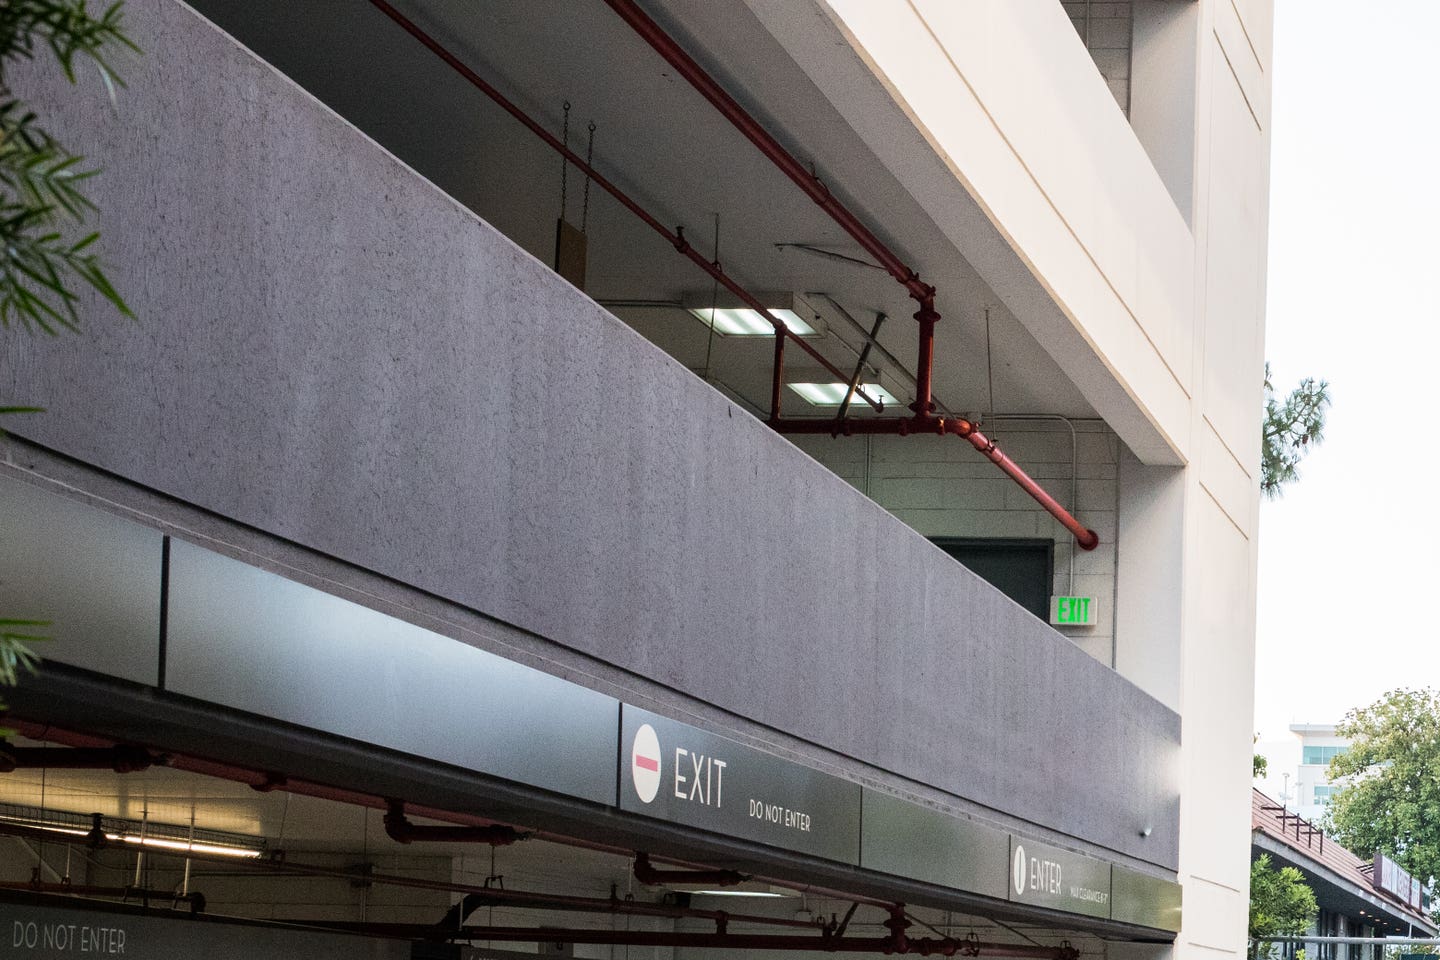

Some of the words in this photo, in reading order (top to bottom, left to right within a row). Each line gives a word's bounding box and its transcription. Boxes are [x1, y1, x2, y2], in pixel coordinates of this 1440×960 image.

[1057, 597, 1091, 623] EXIT
[675, 747, 727, 808] EXIT
[750, 799, 763, 819] DO
[765, 804, 783, 825] NOT
[785, 809, 811, 832] ENTER
[1031, 857, 1062, 895] ENTER
[13, 921, 38, 948] DO
[43, 924, 76, 950] NOT
[81, 926, 126, 953] ENTER
